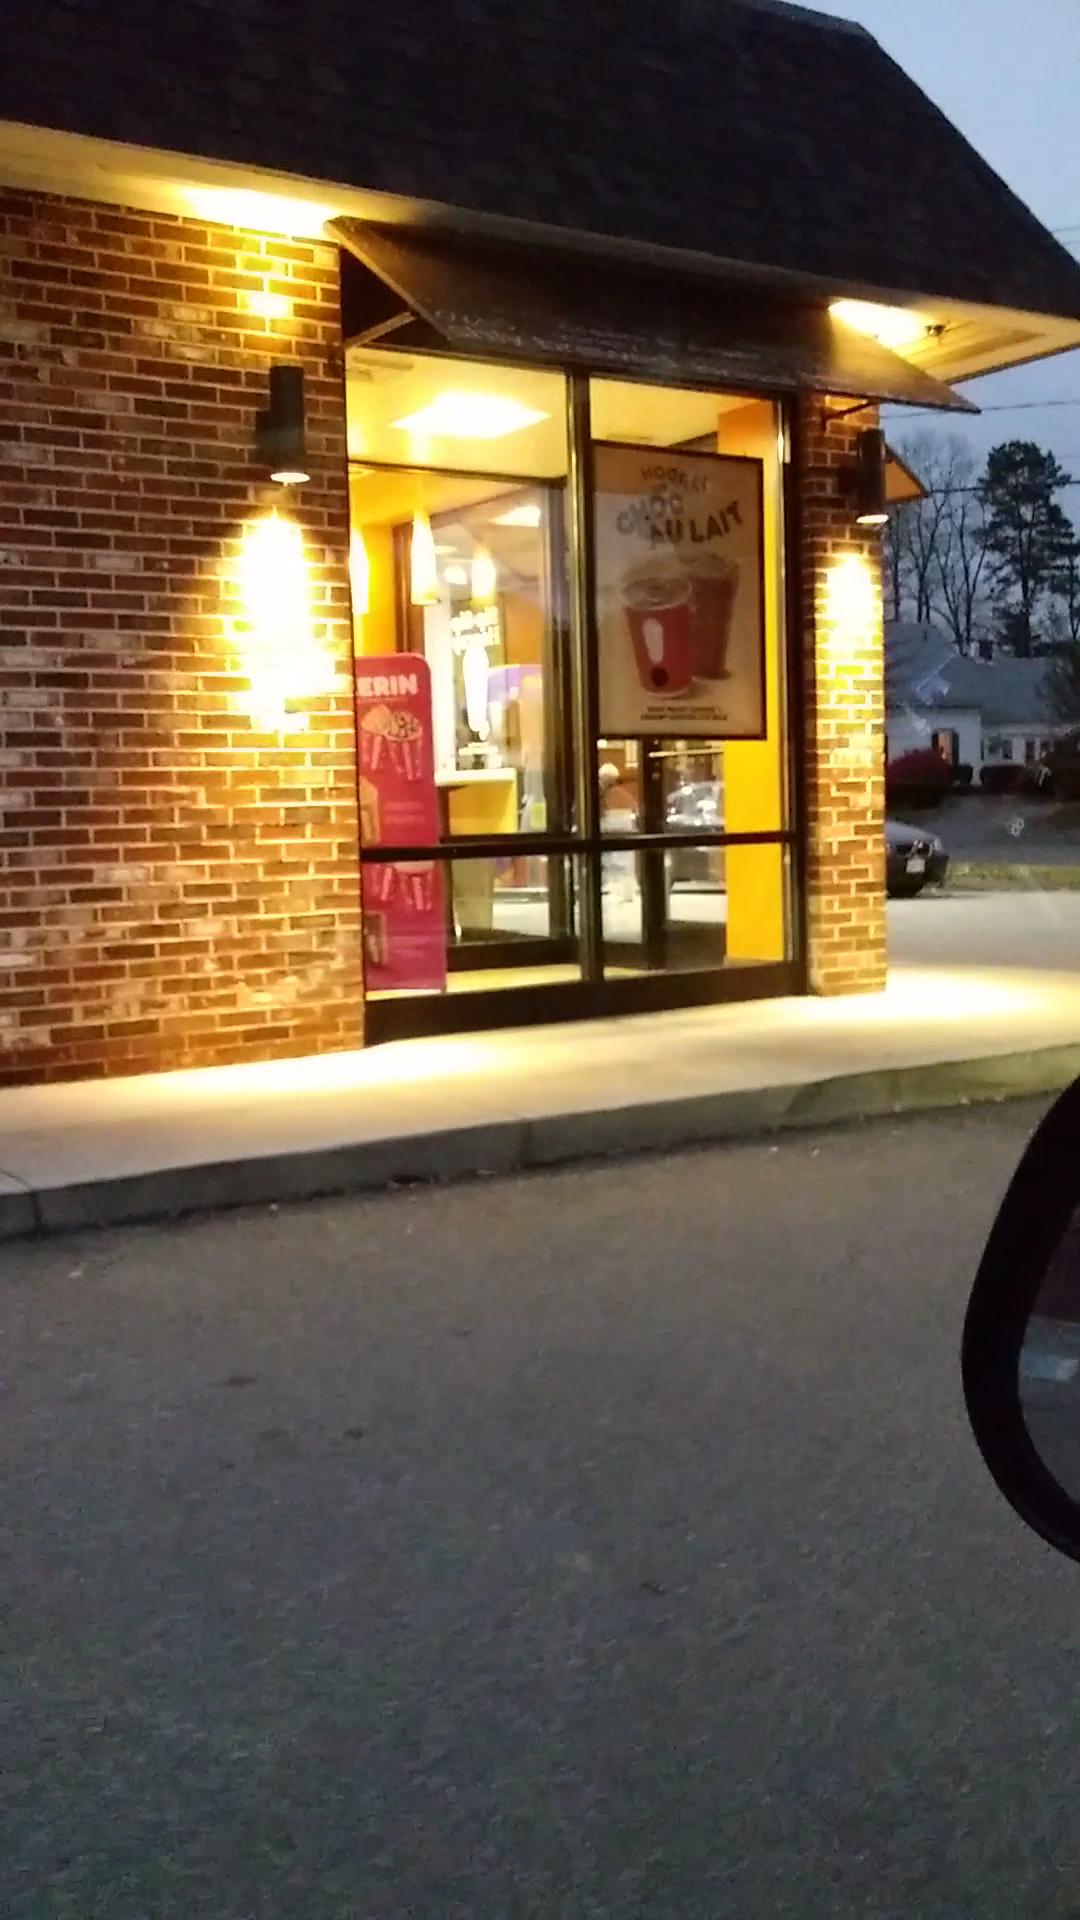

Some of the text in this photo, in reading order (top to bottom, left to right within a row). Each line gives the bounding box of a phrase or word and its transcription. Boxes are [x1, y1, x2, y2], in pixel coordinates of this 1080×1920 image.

[649, 500, 744, 546] AU LAIT
[356, 673, 418, 697] ERIN
